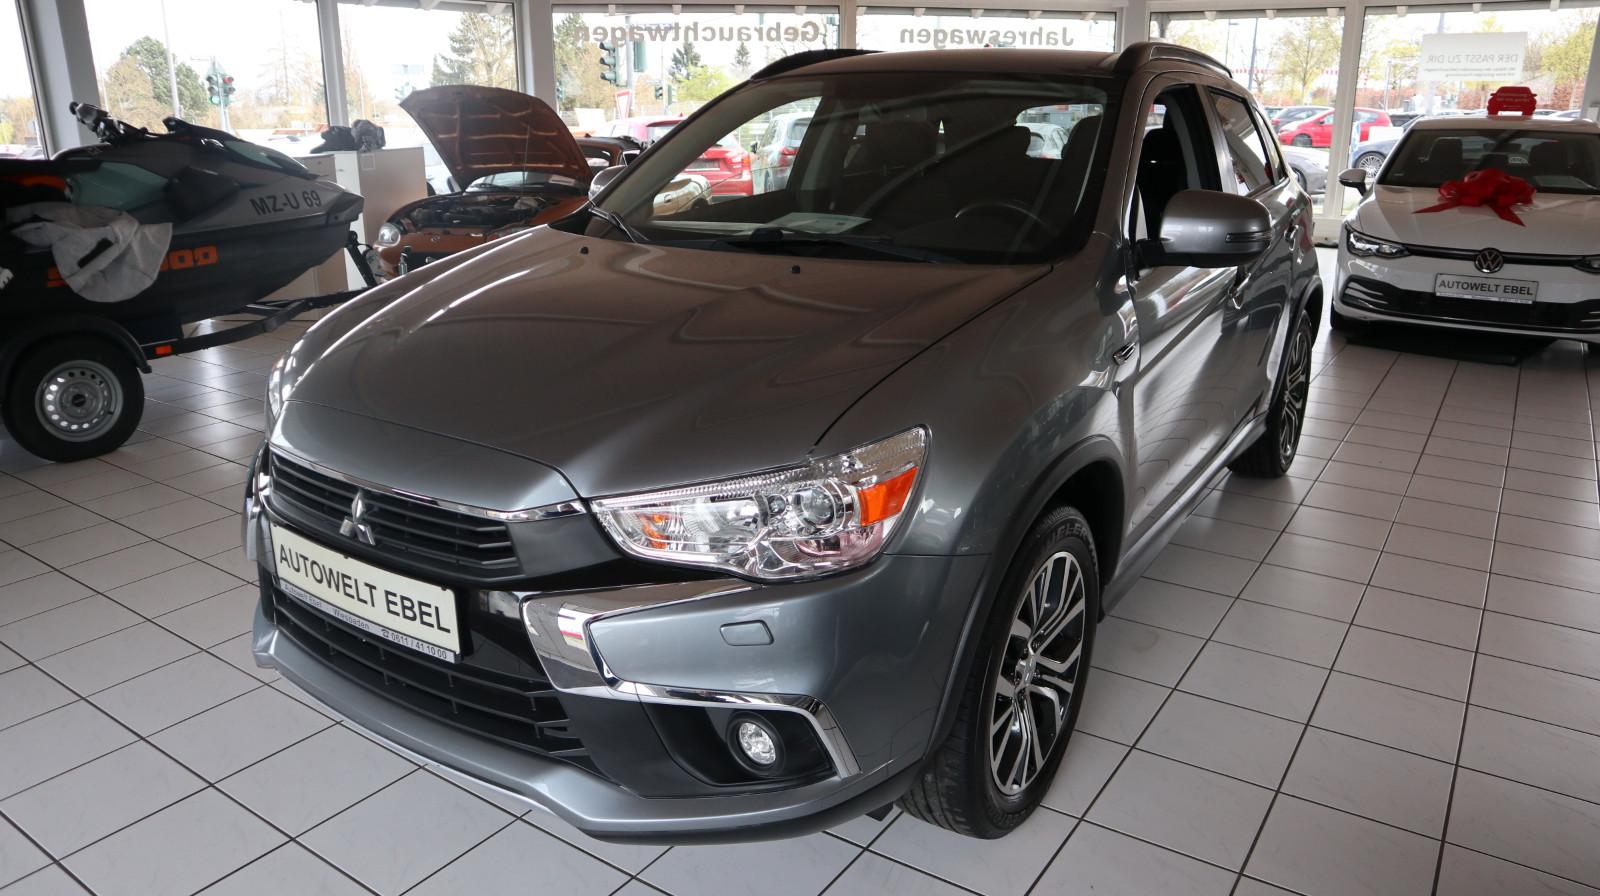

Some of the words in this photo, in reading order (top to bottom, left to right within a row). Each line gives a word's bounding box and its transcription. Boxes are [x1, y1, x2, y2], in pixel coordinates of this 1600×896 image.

[249, 192, 300, 216] MZ-U
[302, 190, 322, 208] 69
[1439, 280, 1501, 293] AUTOWELT
[1503, 285, 1534, 296] EBEL
[279, 544, 377, 608] AUTOWELT
[384, 590, 452, 634] EBEL
[391, 630, 409, 646] 0611
[415, 640, 425, 652] 41
[426, 645, 436, 656] 10
[436, 649, 447, 660] 00
